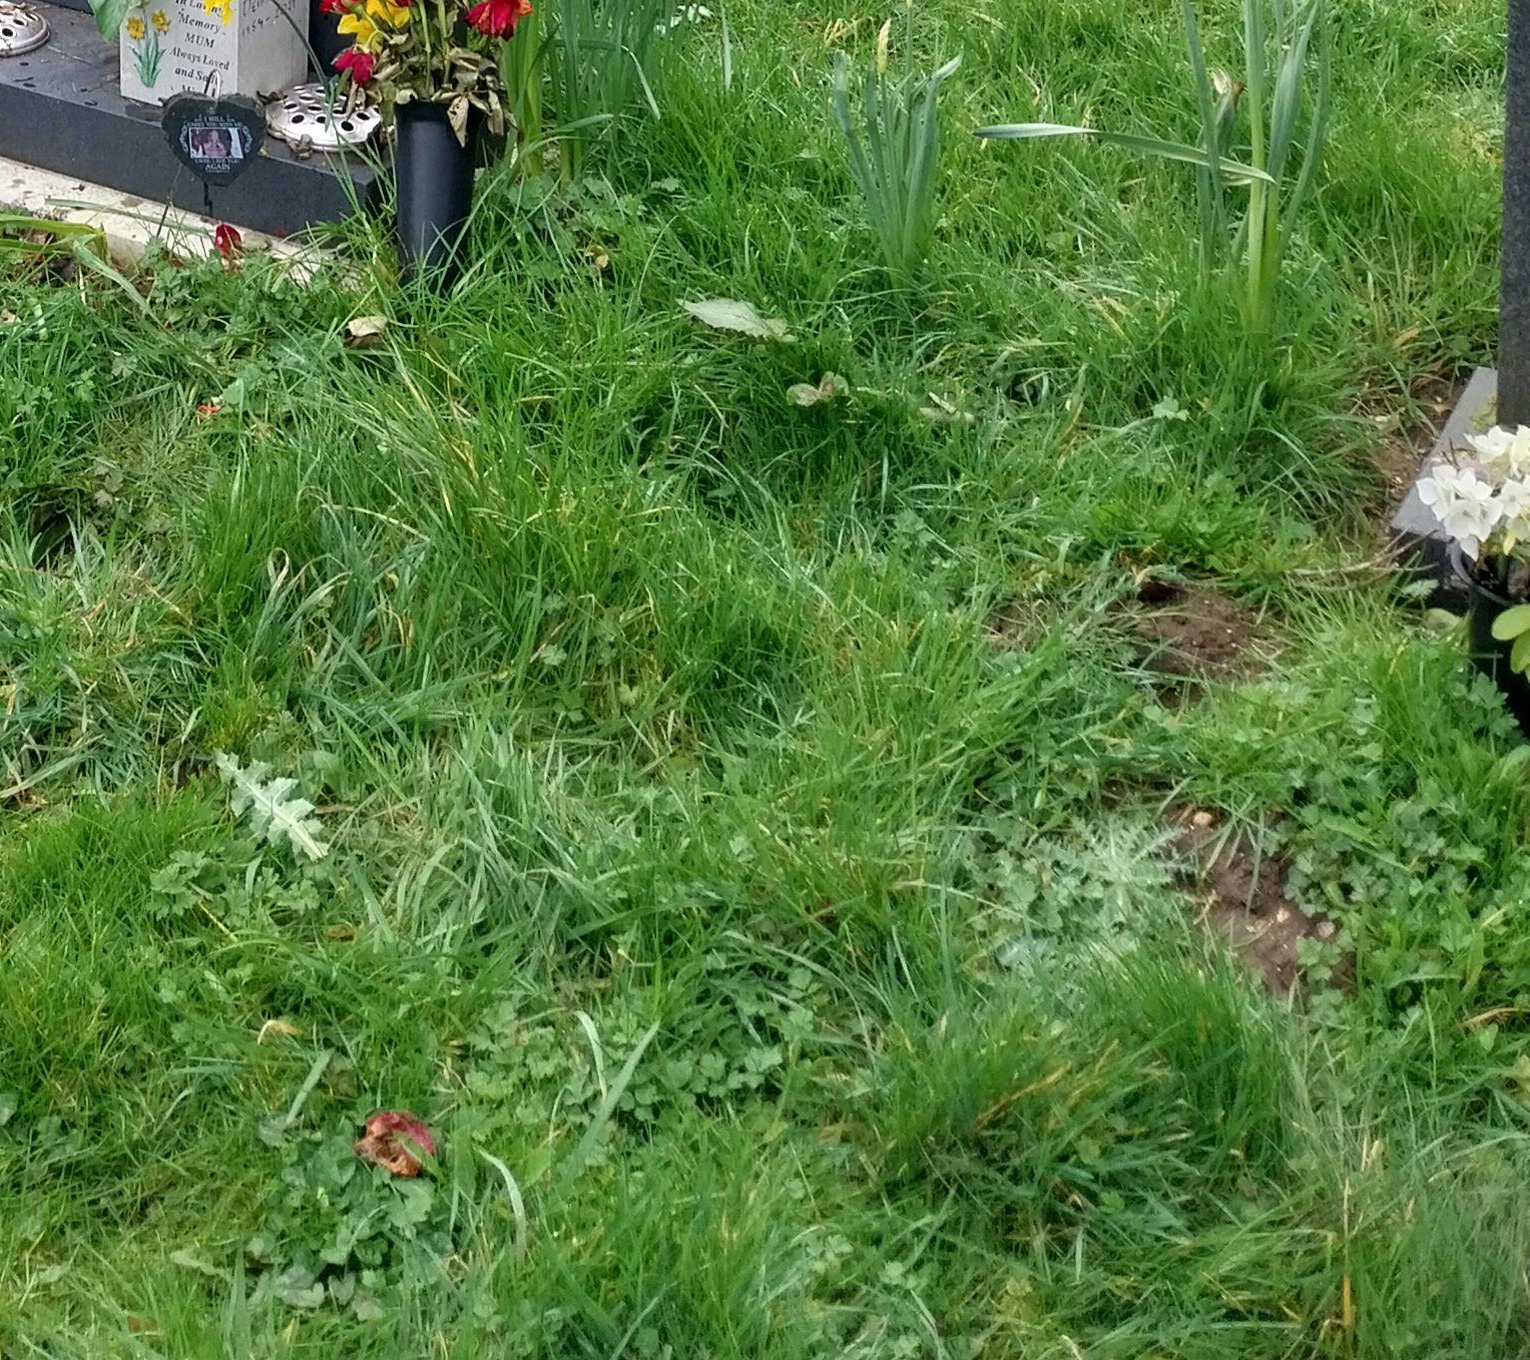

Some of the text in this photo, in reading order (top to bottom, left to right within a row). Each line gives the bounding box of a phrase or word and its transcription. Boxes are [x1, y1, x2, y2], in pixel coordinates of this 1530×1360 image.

[178, 12, 221, 34] Memory
[184, 32, 215, 48] MUM
[170, 46, 230, 70] Always Loved
[174, 67, 194, 78] and
